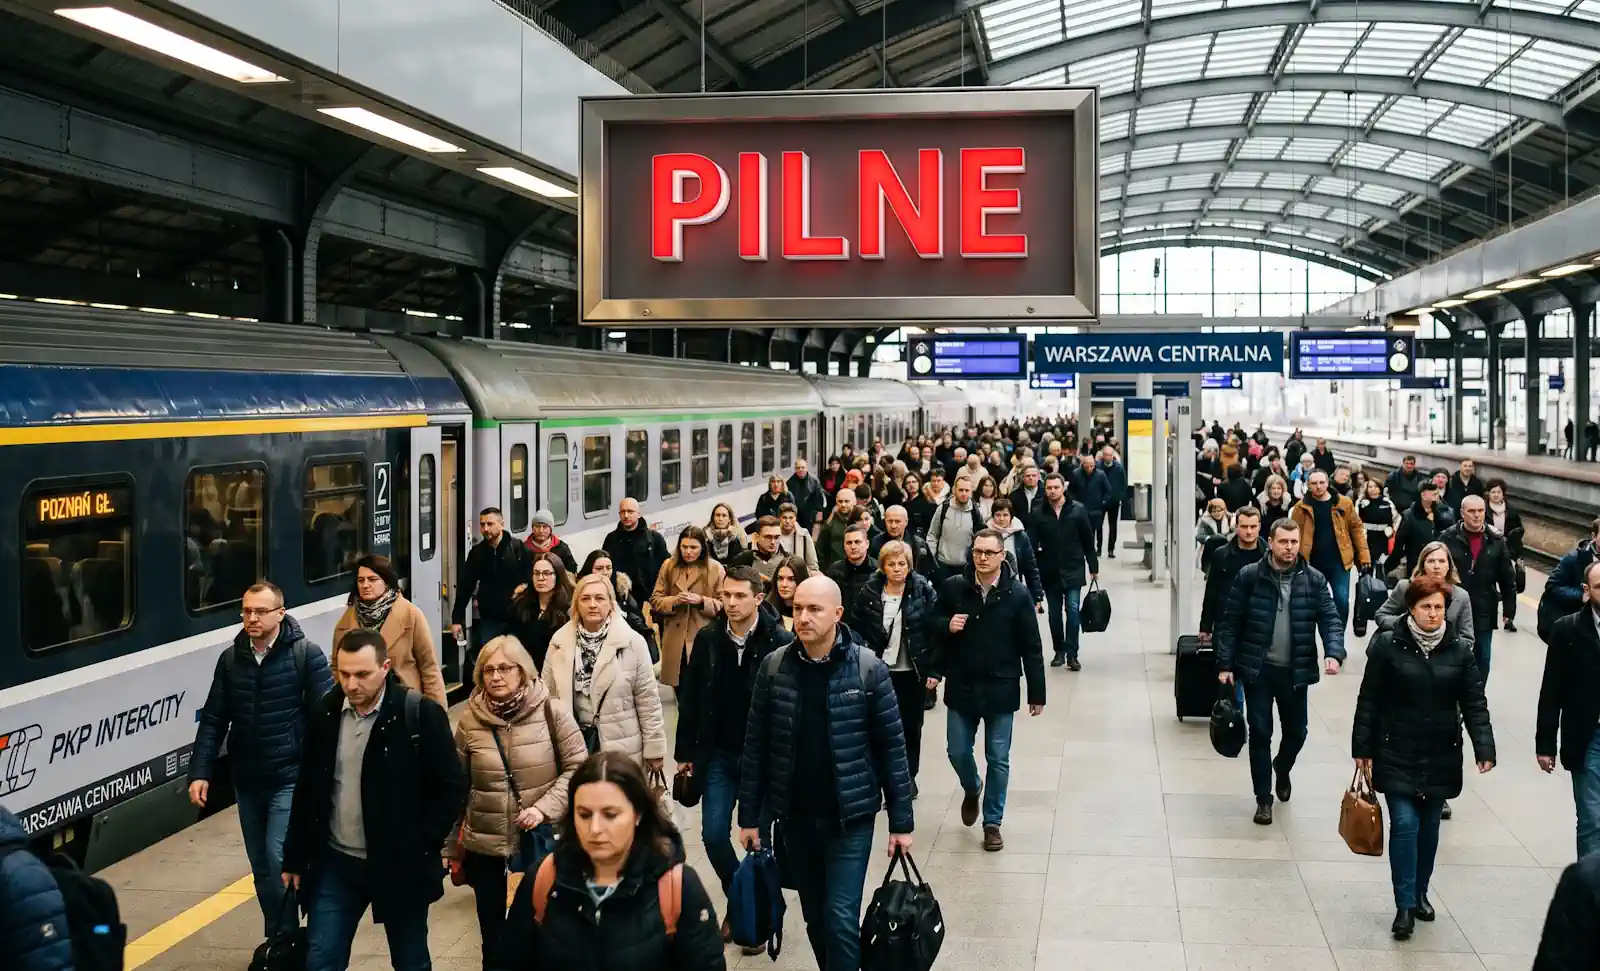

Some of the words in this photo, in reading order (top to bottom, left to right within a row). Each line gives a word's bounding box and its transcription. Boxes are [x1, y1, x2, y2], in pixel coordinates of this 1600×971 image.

[652, 147, 1028, 262] PILNE
[1044, 345, 1153, 363] WARSZAWA
[1158, 345, 1272, 362] CENTRALNA
[40, 491, 91, 521] POZNAŃ
[377, 467, 387, 506] 2
[49, 723, 92, 764] PKP
[95, 691, 186, 748] INTERCITY
[20, 799, 83, 835] ARSZAWA
[84, 766, 152, 809] CENTRALNA
